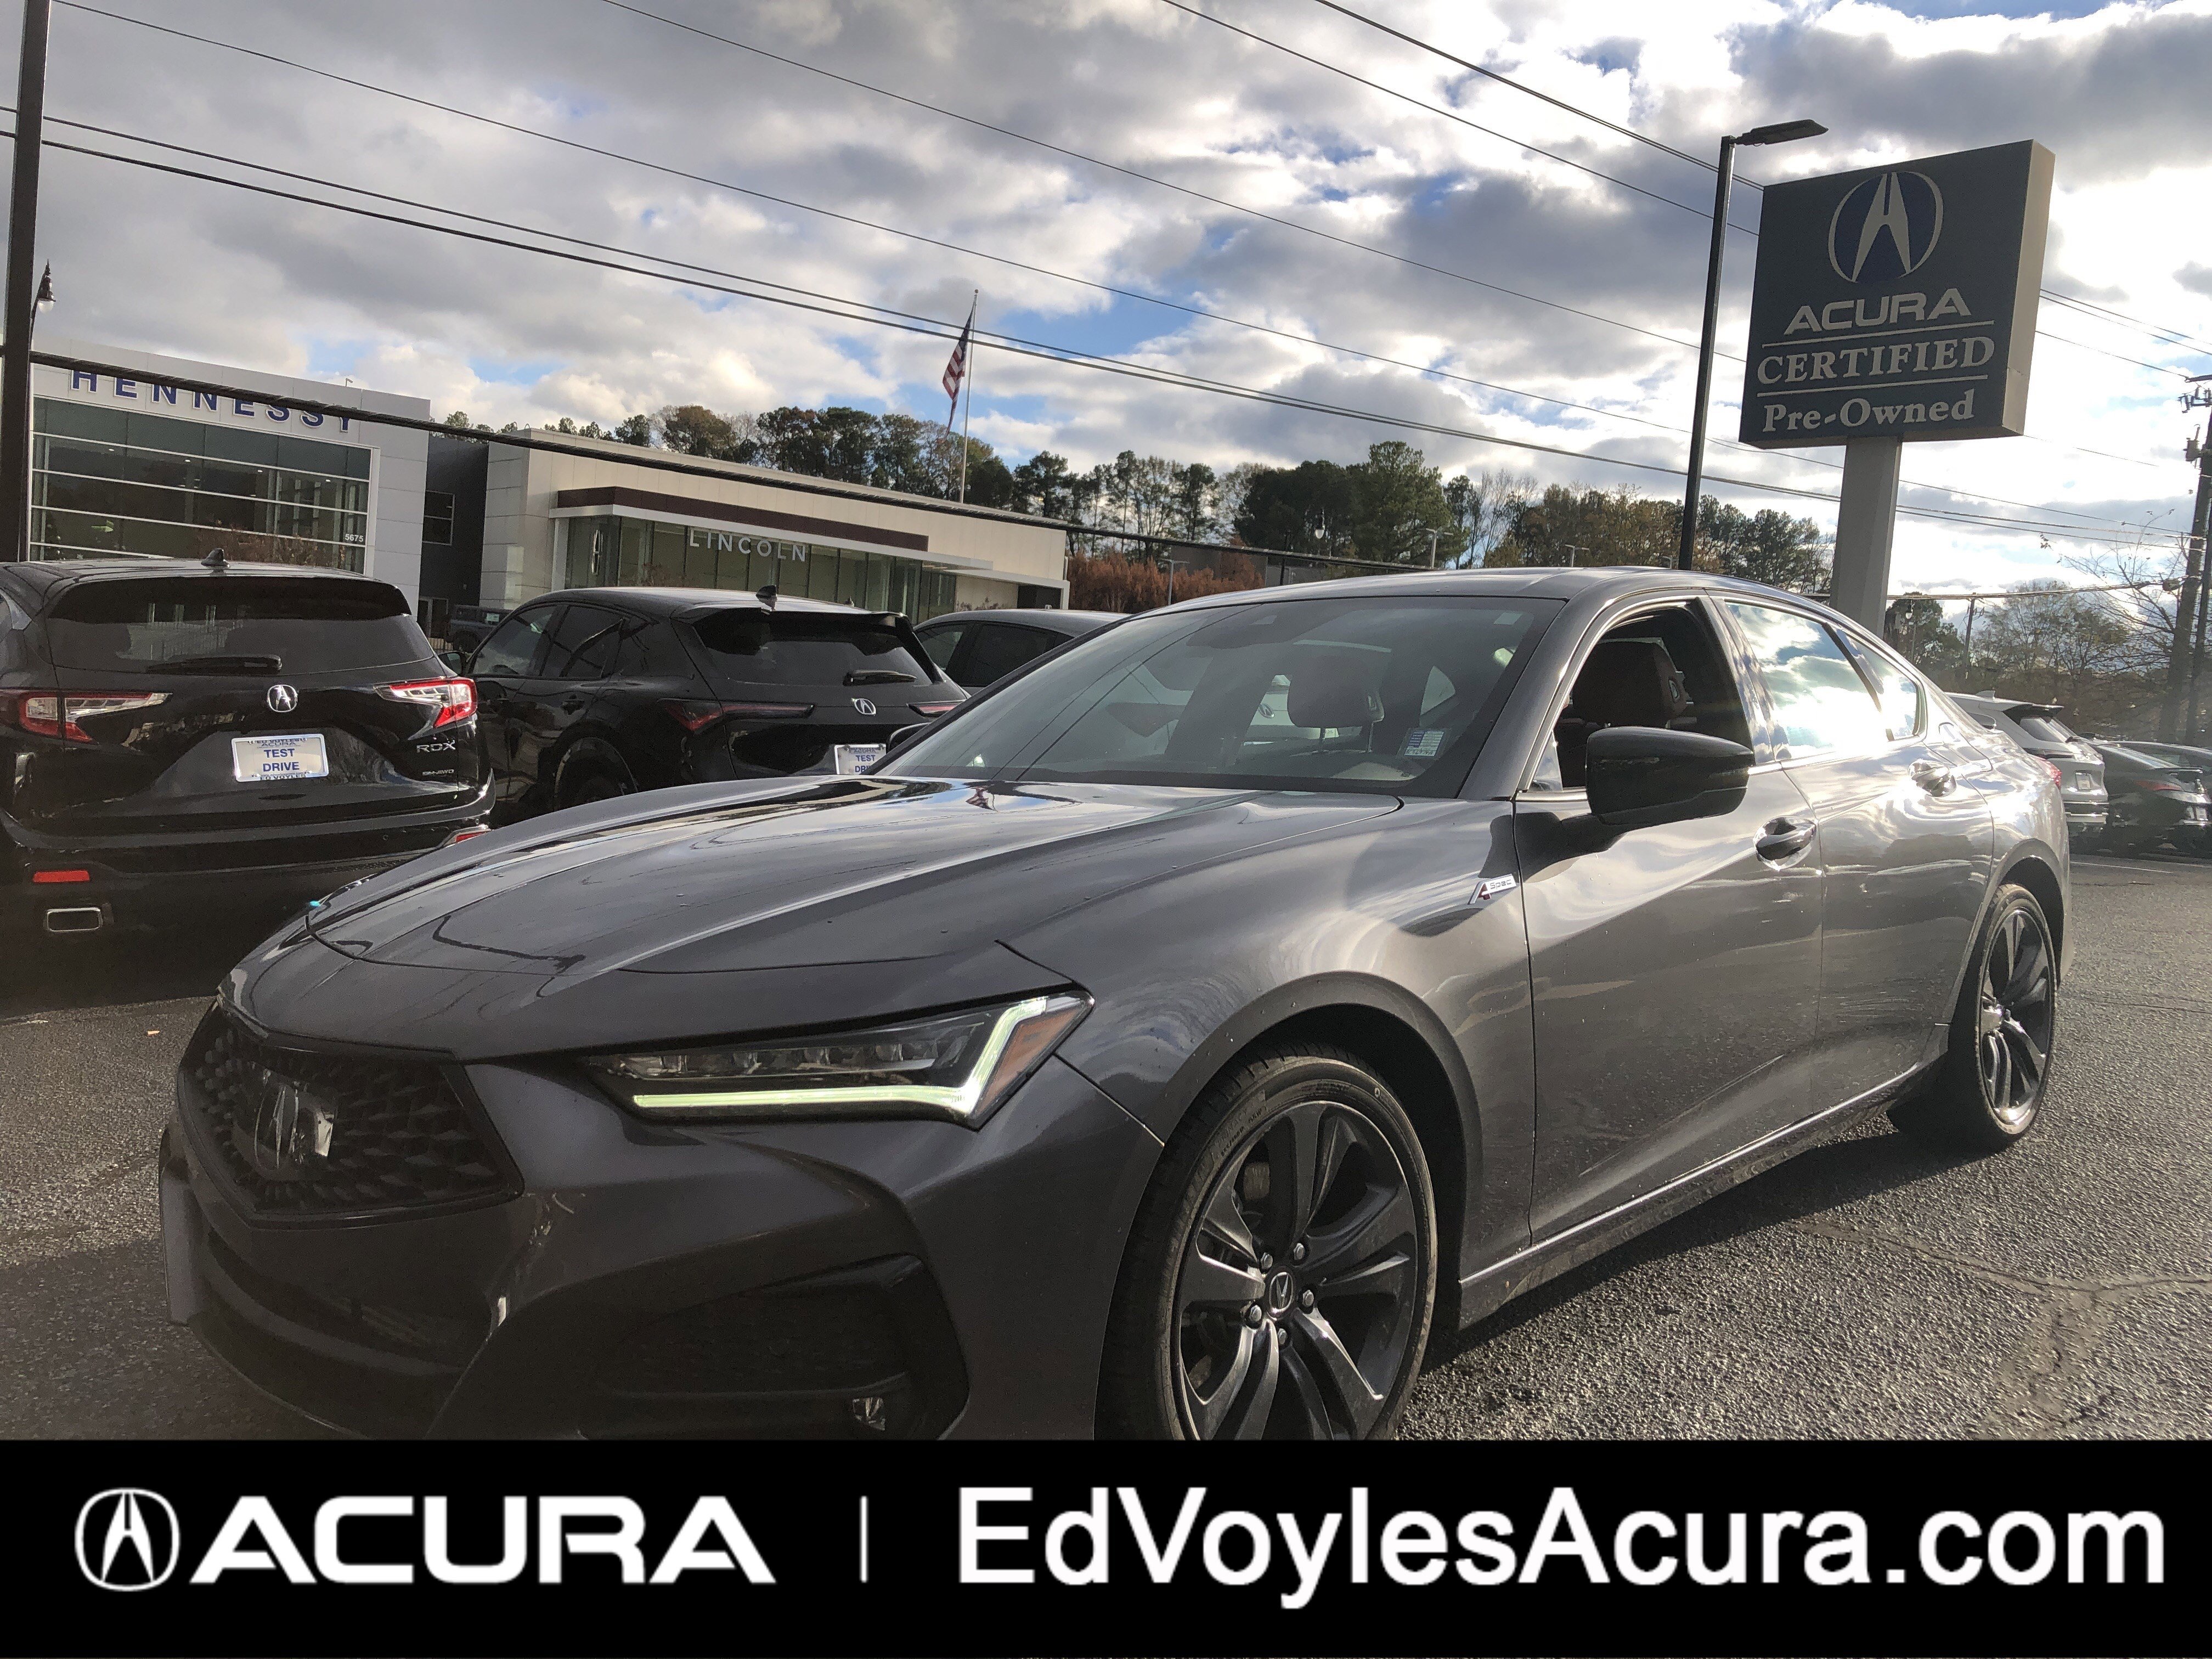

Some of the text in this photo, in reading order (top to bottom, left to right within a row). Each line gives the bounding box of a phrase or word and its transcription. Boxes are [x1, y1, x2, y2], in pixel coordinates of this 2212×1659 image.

[1784, 287, 1972, 335] ACURA
[1757, 336, 1995, 384] CERTIFIED
[1762, 388, 1974, 432] Pre-Owned
[345, 533, 364, 543] 5675
[690, 529, 805, 562] LINCOLN
[263, 748, 295, 758] TEST
[416, 740, 456, 753] RDX
[263, 761, 300, 772] DRIVE
[1489, 879, 1512, 889] Spec
